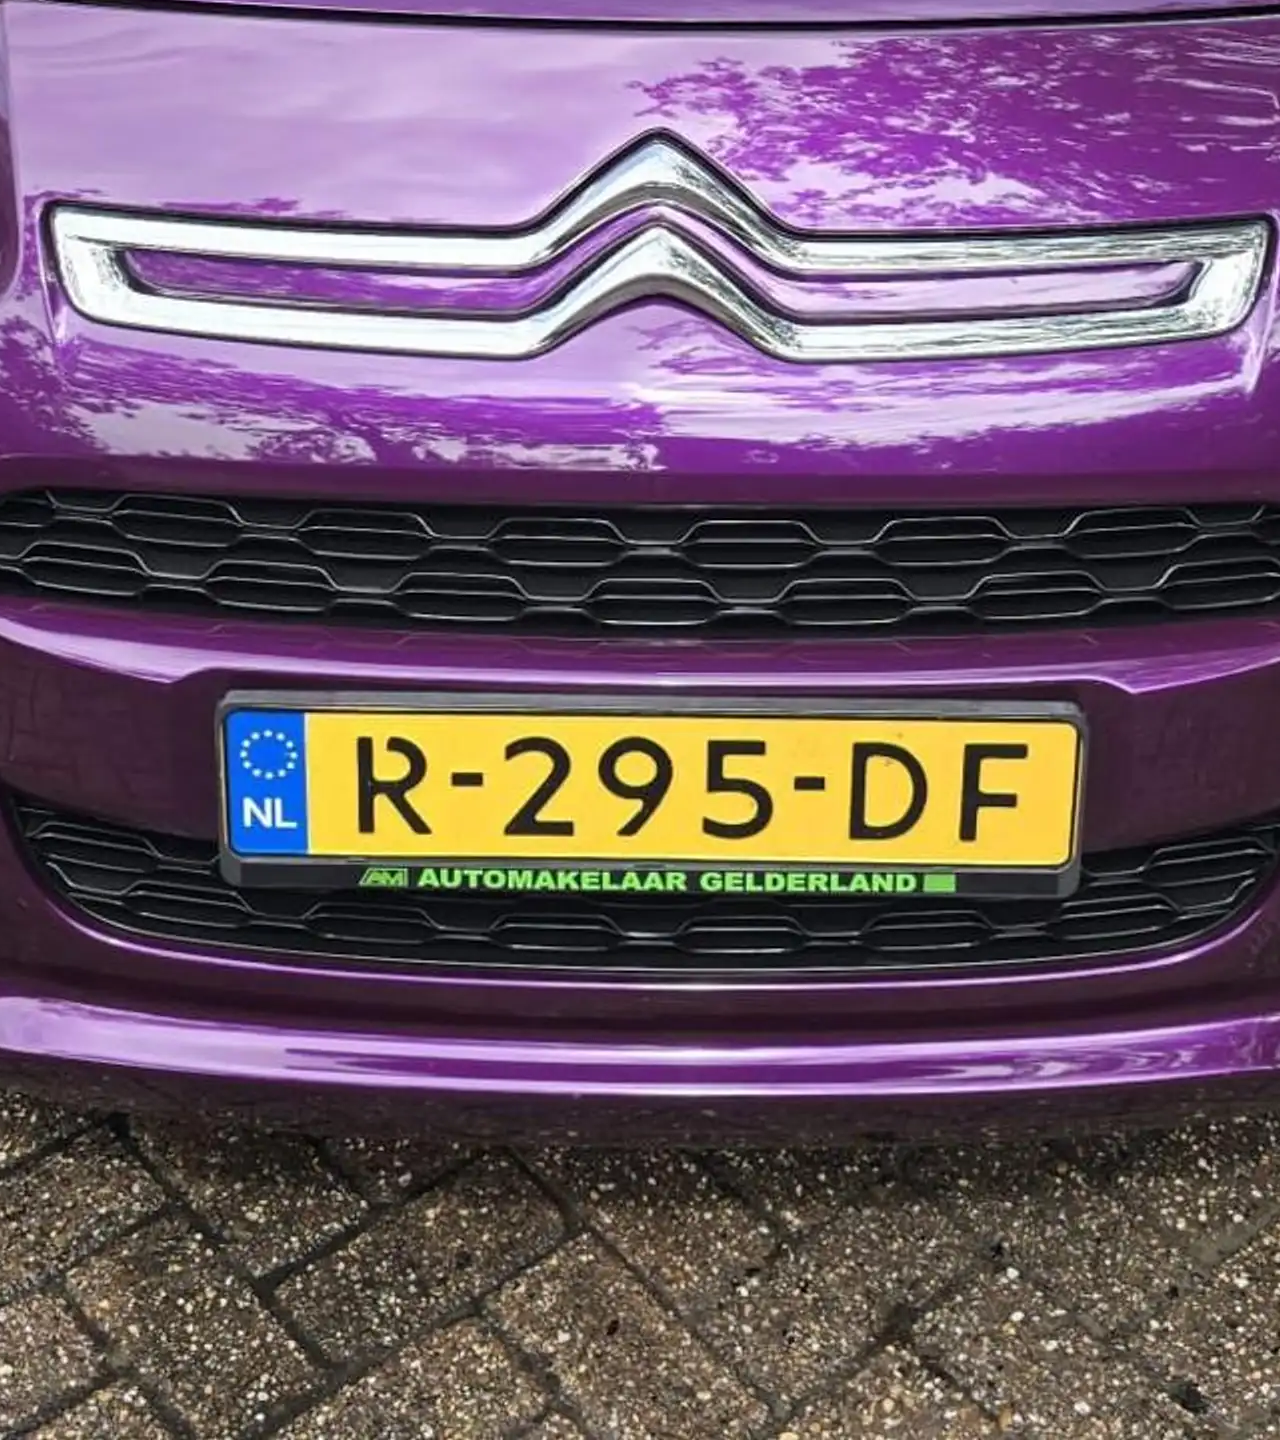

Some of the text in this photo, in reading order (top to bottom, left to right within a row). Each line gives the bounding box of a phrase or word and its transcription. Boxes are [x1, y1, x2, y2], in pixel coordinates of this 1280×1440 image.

[356, 735, 1030, 843] R-295-DF
[242, 797, 298, 829] NL
[418, 867, 687, 892] AUTOMAKELAAR
[699, 871, 918, 894] GELDERLAND
